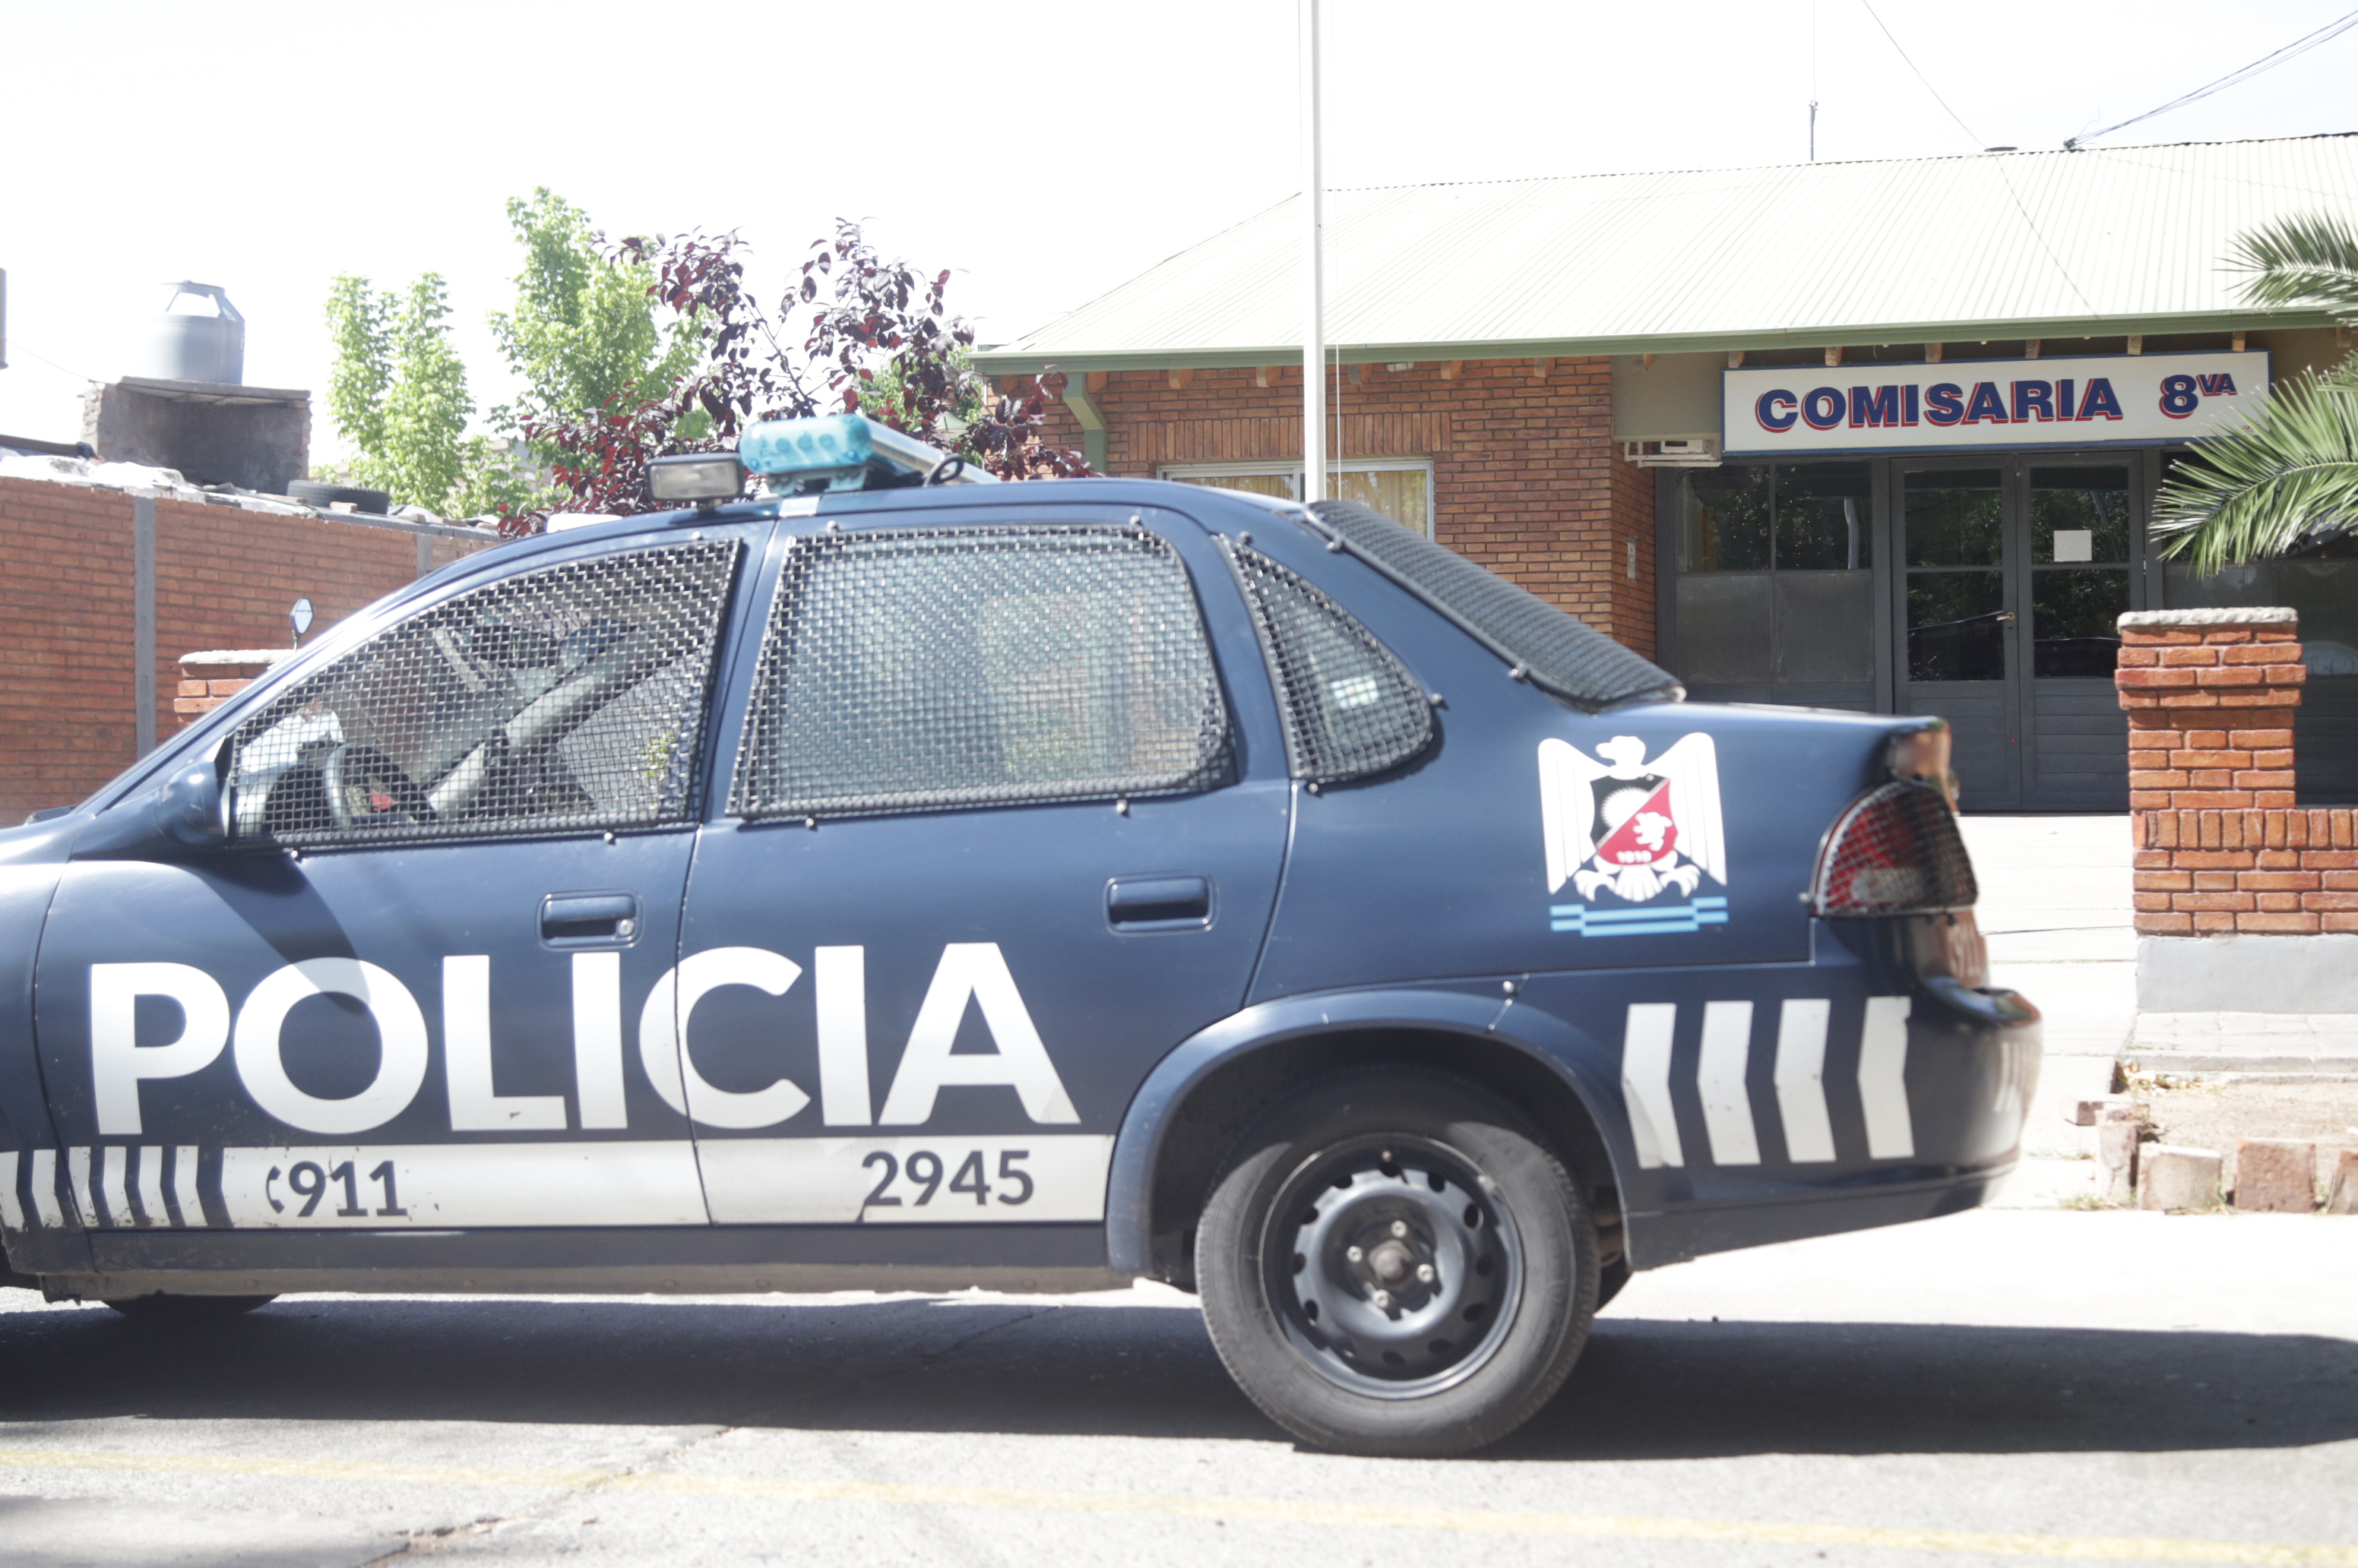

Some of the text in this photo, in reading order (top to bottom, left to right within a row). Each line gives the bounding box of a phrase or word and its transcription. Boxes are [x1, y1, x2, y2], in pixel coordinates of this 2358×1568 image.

[1755, 377, 2124, 434] COMISARIA
[90, 942, 1081, 1134] POLICIA
[289, 1160, 408, 1217] 911
[860, 1150, 1033, 1206] 2945
